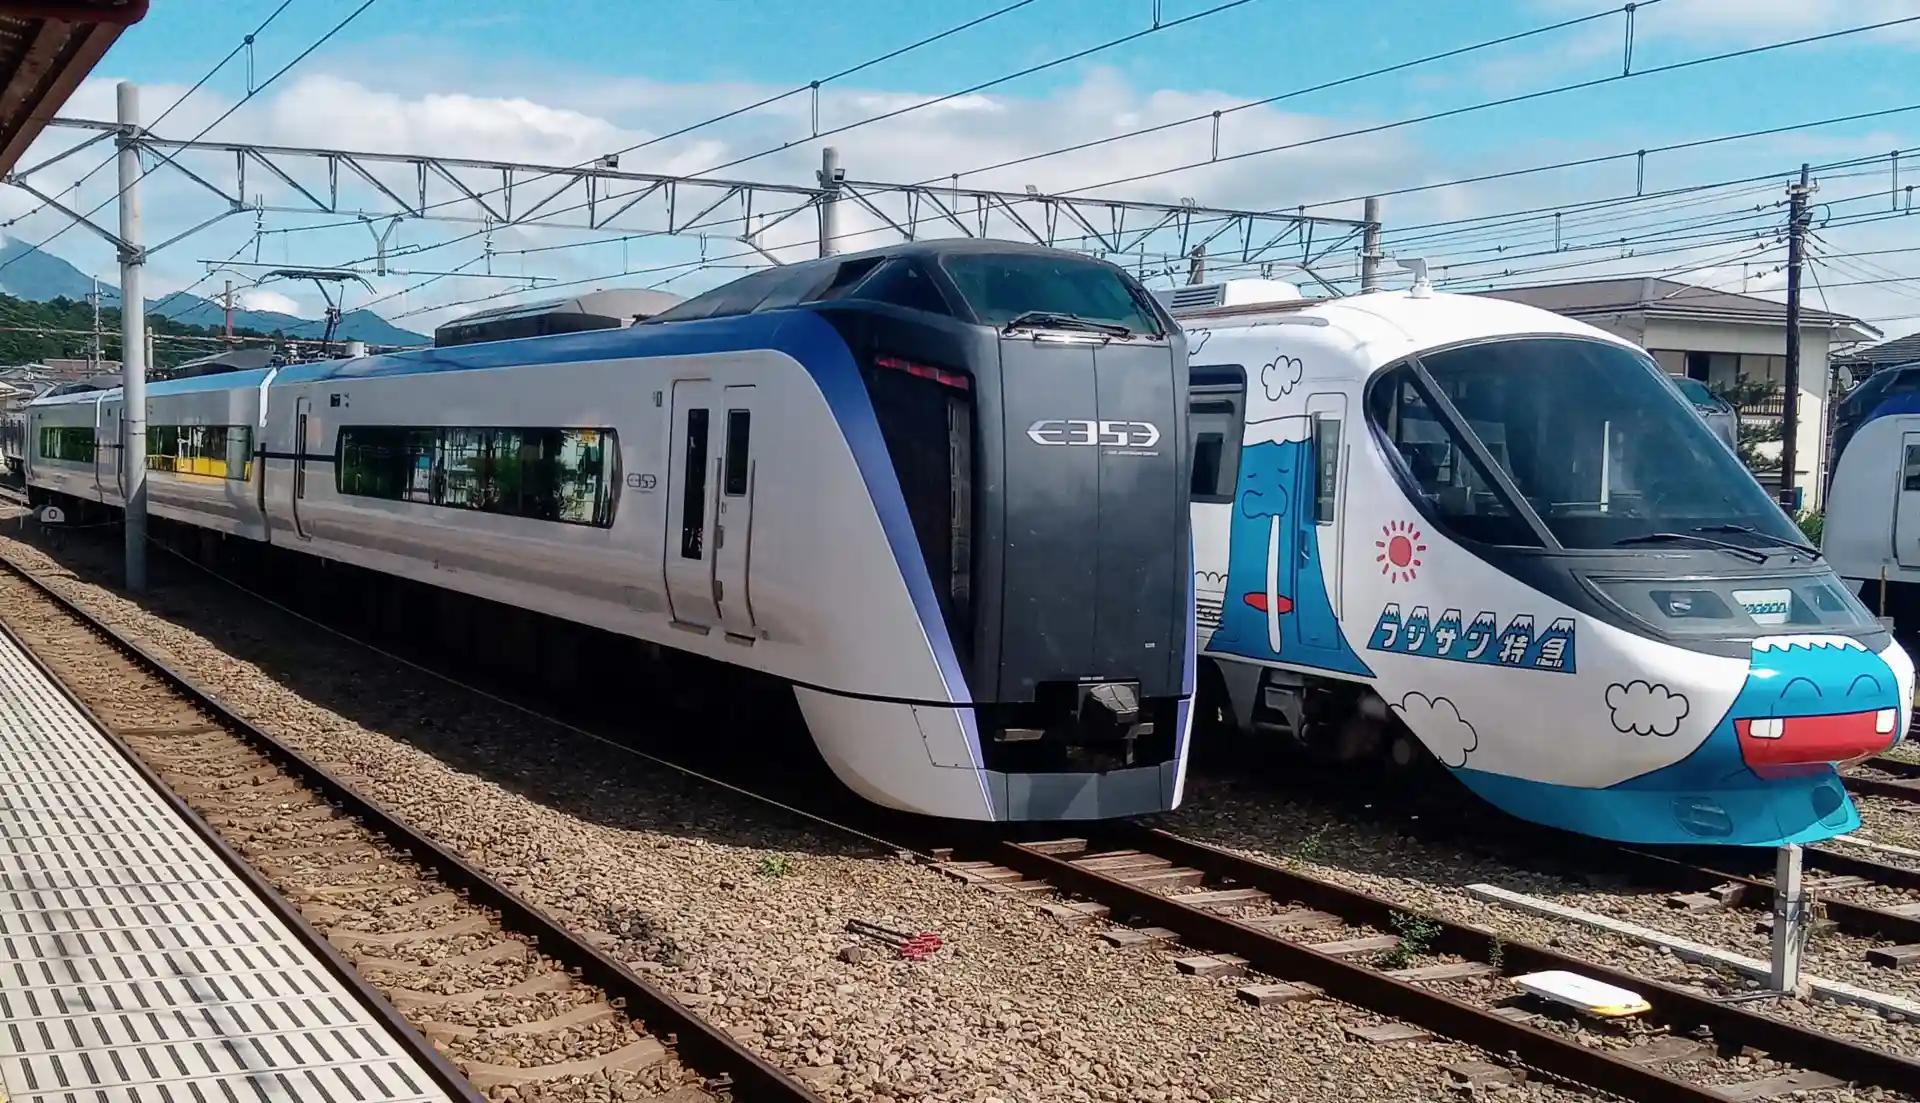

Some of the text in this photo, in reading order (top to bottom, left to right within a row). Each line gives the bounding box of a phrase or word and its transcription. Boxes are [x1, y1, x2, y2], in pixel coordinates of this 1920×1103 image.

[1026, 420, 1161, 447] E353
[1380, 622, 1567, 668] フジサン特急
